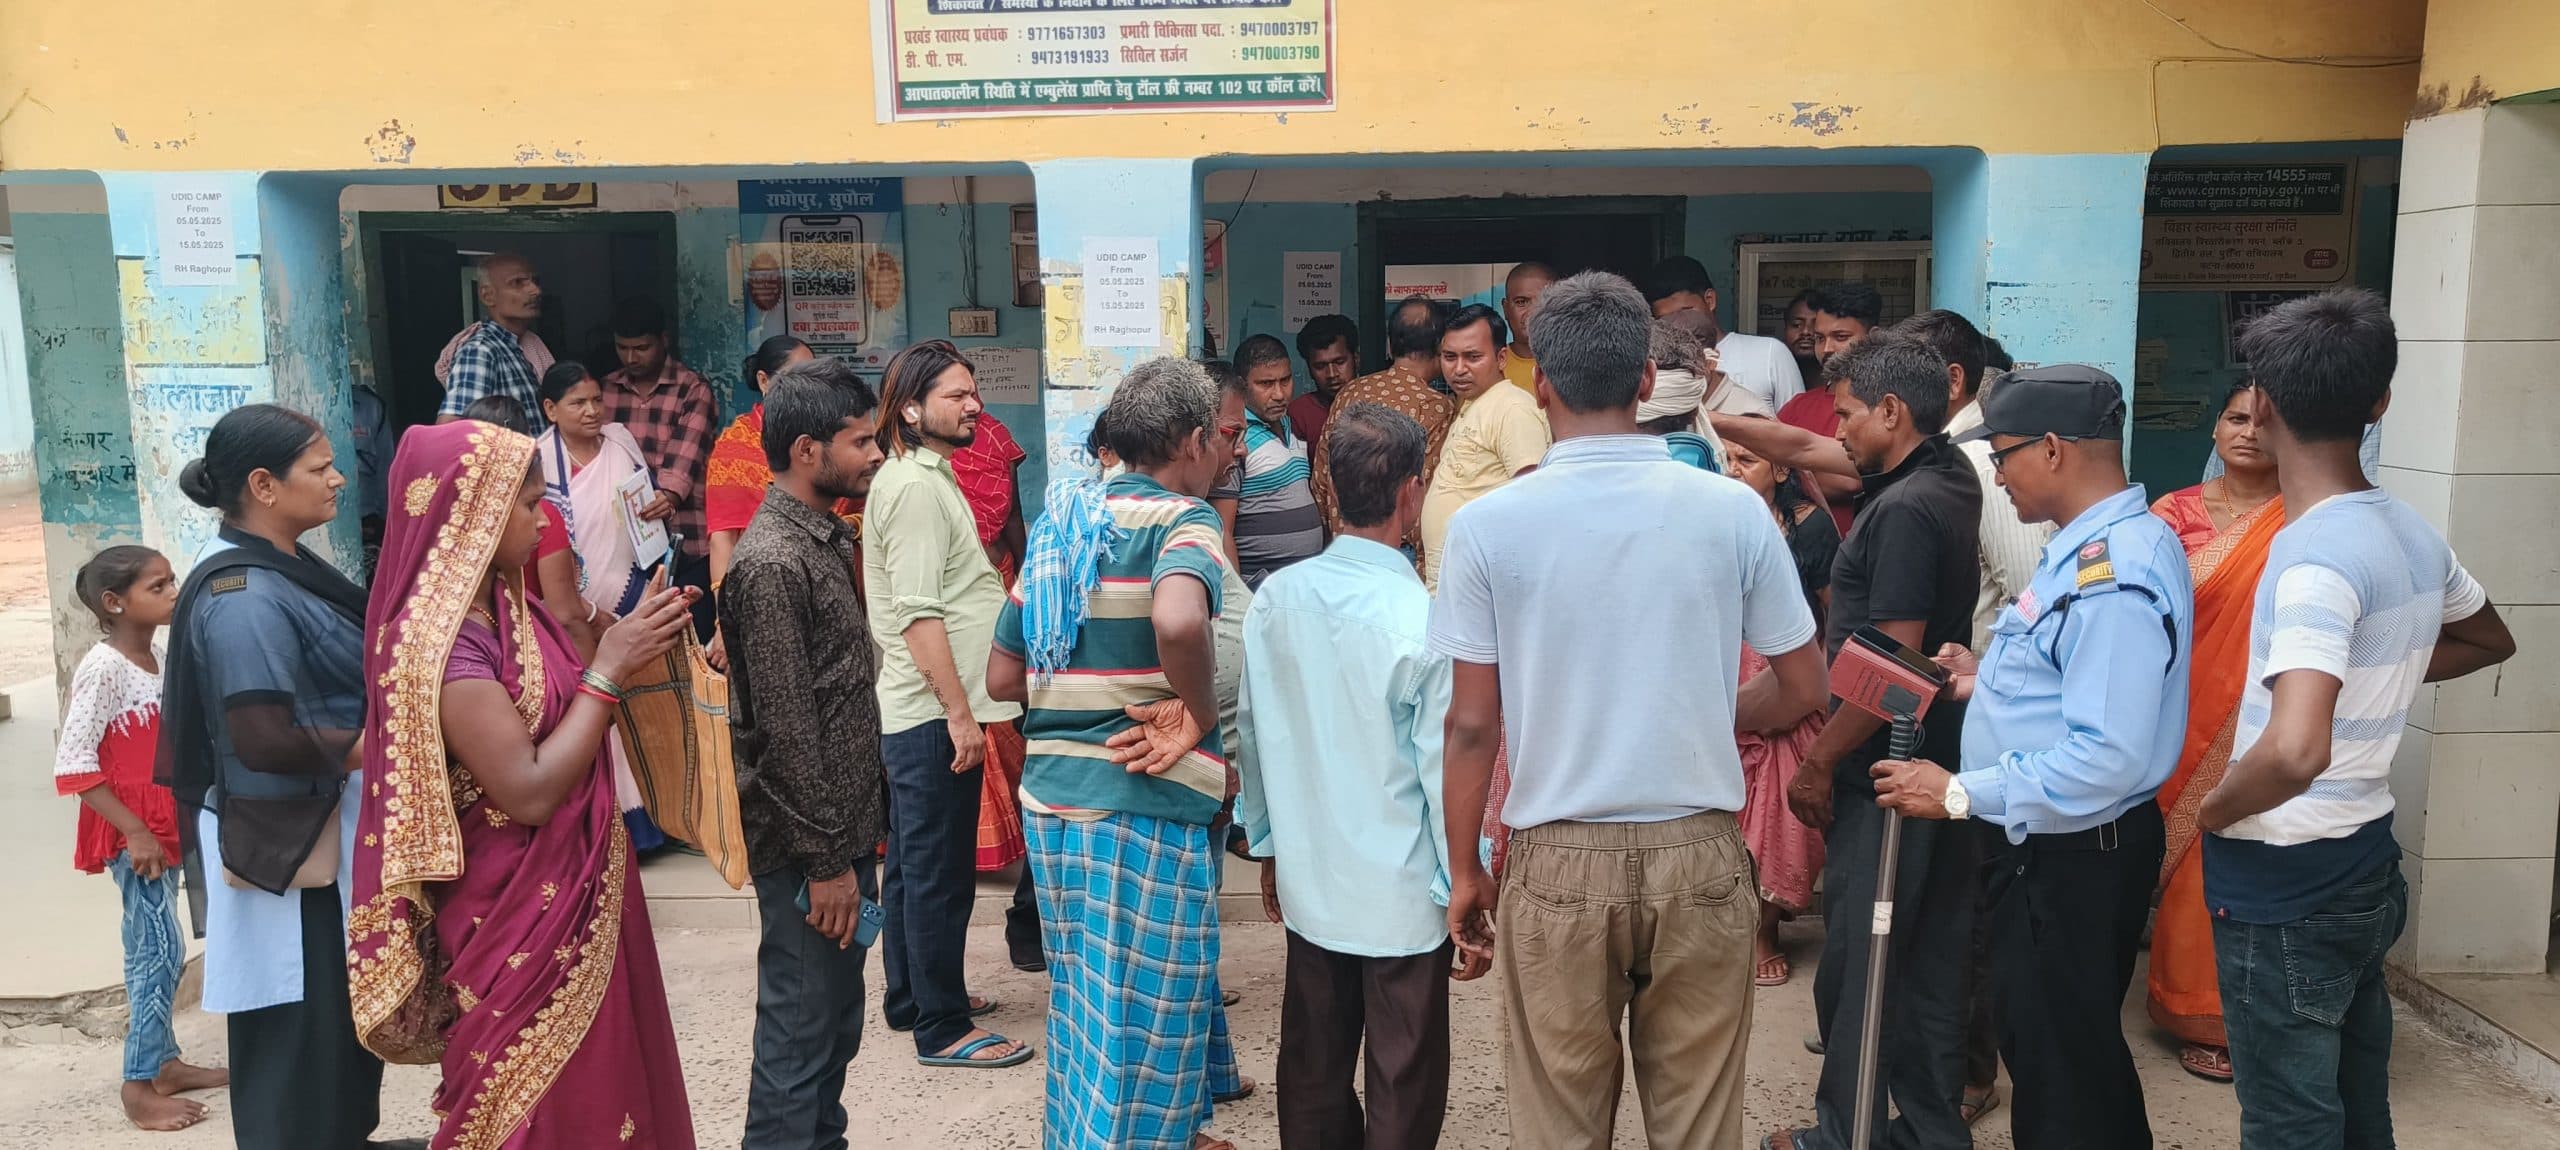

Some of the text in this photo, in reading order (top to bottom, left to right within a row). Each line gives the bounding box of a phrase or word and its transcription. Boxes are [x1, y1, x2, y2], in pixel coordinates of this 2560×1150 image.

[904, 26, 931, 44] प्रखंड
[935, 29, 970, 43] स्वास्थ्य
[975, 24, 1008, 42] प्रबंधक
[1028, 26, 1105, 41] 9771657303
[1120, 21, 1149, 39] प्रभारी
[1153, 20, 1197, 39] चिकित्सा
[1201, 23, 1225, 37] पदा.
[1240, 22, 1318, 36] 9470003797
[905, 51, 921, 68] डी.
[925, 51, 941, 67] पी.
[946, 53, 967, 67] एम.
[1032, 50, 1109, 65] 9473191933
[1120, 46, 1155, 63] सिविल
[1160, 44, 1187, 62] सर्जन
[1242, 46, 1319, 60] 9470003790
[905, 76, 1321, 102] आपातकालीन स्थिति में एम्बुलेंस प्राप्ति हेतु टॉल फ्री नम्बर 102 पर कॉल करें।
[2222, 171, 2241, 182] कॉल
[2266, 169, 2306, 182] 14555
[2167, 184, 2315, 197] www.cgrms.pmjay.gov.in
[2317, 186, 2329, 194] पर
[171, 193, 222, 201] UDID CAMP
[767, 190, 875, 211] राघोपुर, सुपौल
[2160, 197, 2195, 208] शिकायत
[186, 205, 209, 213] From
[176, 217, 222, 225] 05.05.2025
[2164, 218, 2297, 235] बिहार स्वास्थ्य सुरक्षा समिति
[194, 229, 206, 237] To
[179, 241, 224, 249] 15.05.2025
[1096, 253, 1147, 262] UDID CAMP
[174, 264, 232, 275] RH Raghopur
[1110, 266, 1133, 274] From
[1099, 278, 1145, 286] 05.05.2025
[1116, 290, 1129, 298] To
[795, 302, 808, 312] QR
[1101, 302, 1145, 310] 15.05.2025
[792, 322, 810, 332] दवा
[1094, 325, 1152, 336] RH Raghopur
[2077, 563, 2114, 584] SECURITY
[212, 576, 246, 592] SECURITY
